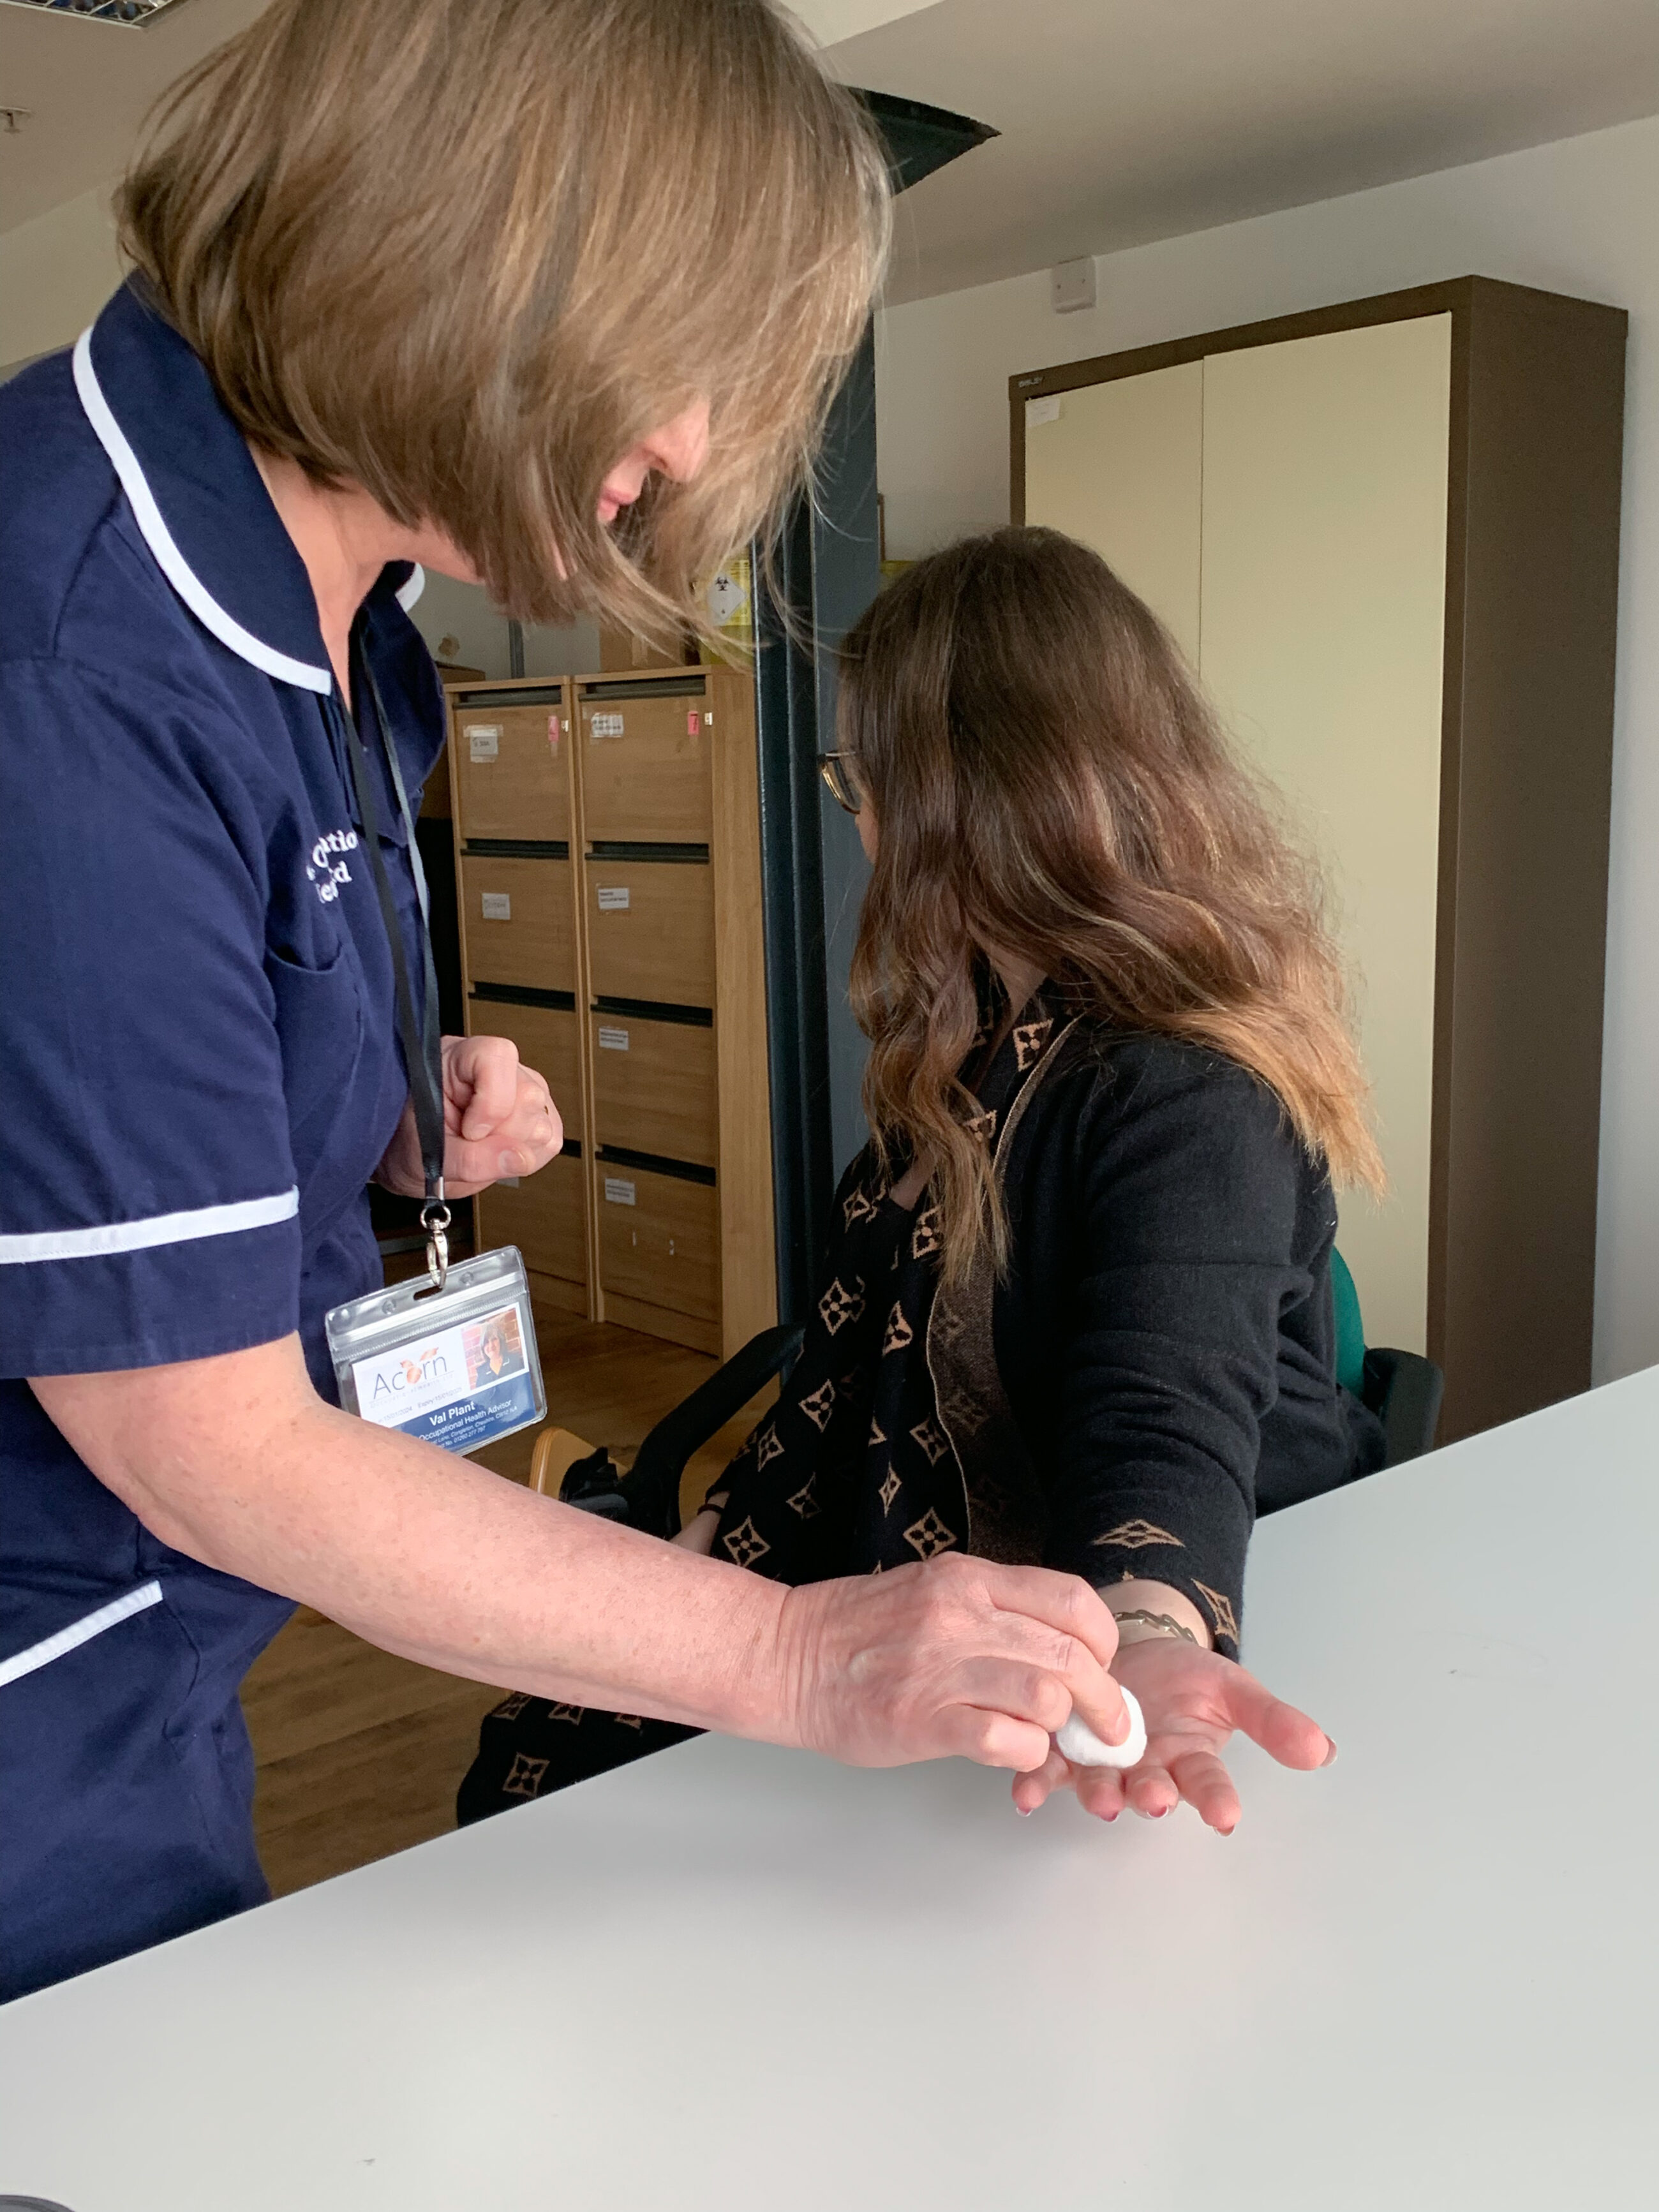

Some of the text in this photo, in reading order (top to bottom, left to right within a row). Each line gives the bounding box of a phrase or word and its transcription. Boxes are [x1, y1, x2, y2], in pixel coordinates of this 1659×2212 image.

[373, 1355, 447, 1399] Acorn
[419, 1399, 512, 1441] Occupational Health Advisor
[429, 1400, 475, 1427] Val Plant
